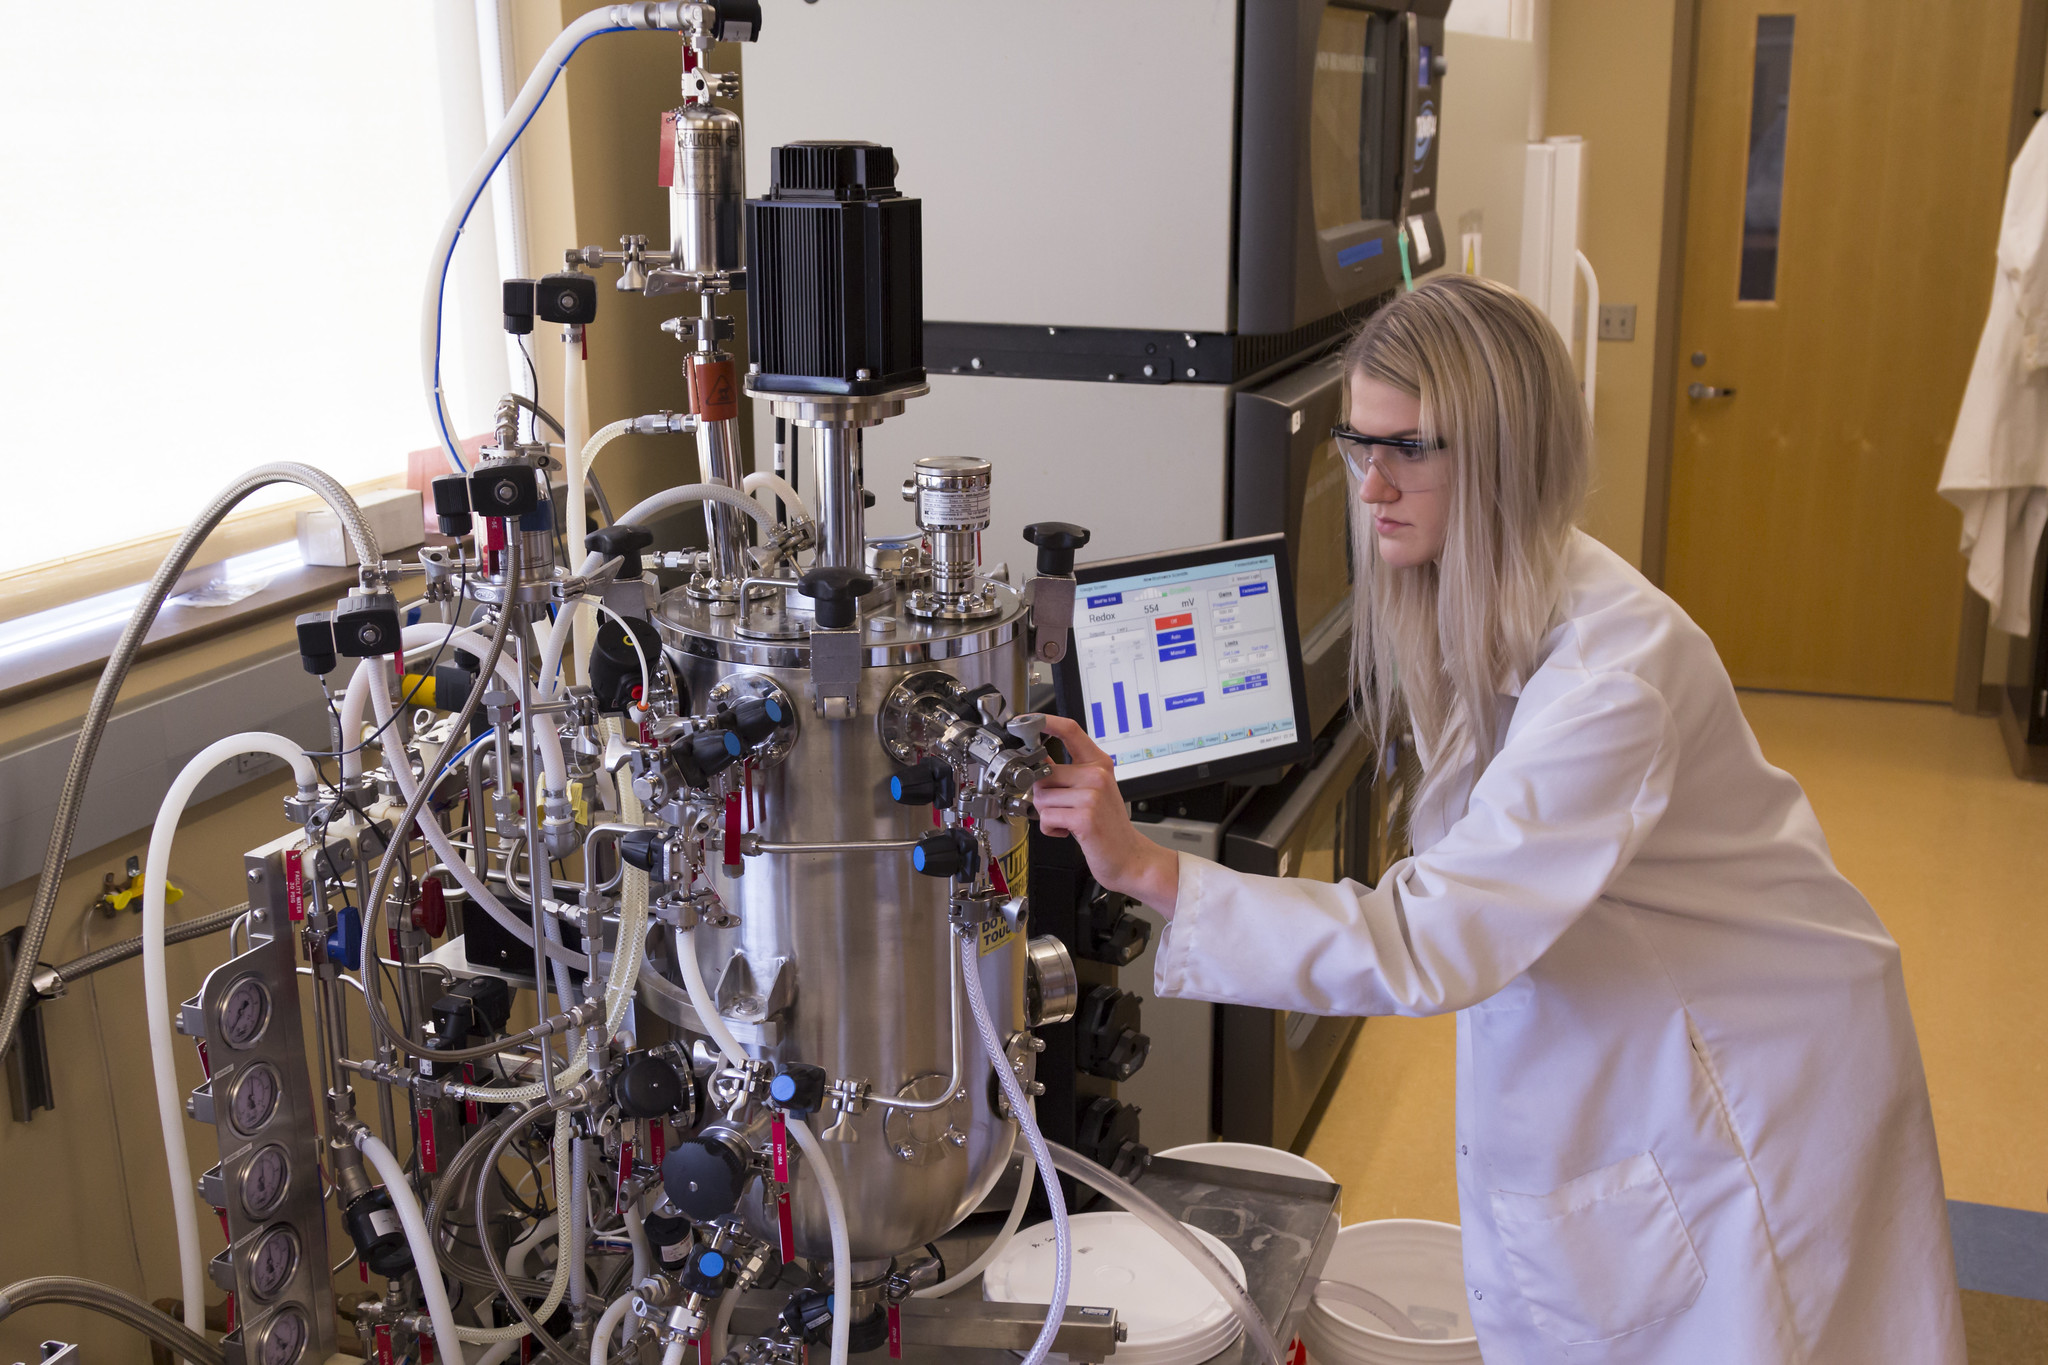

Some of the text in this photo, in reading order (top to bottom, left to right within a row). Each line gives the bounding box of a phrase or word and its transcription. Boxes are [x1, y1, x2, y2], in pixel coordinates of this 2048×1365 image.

[1182, 598, 1195, 608] mV
[1144, 604, 1160, 614] 554
[1089, 612, 1116, 623] Redox
[982, 917, 998, 933] DO
[984, 925, 1011, 946] TOUC
